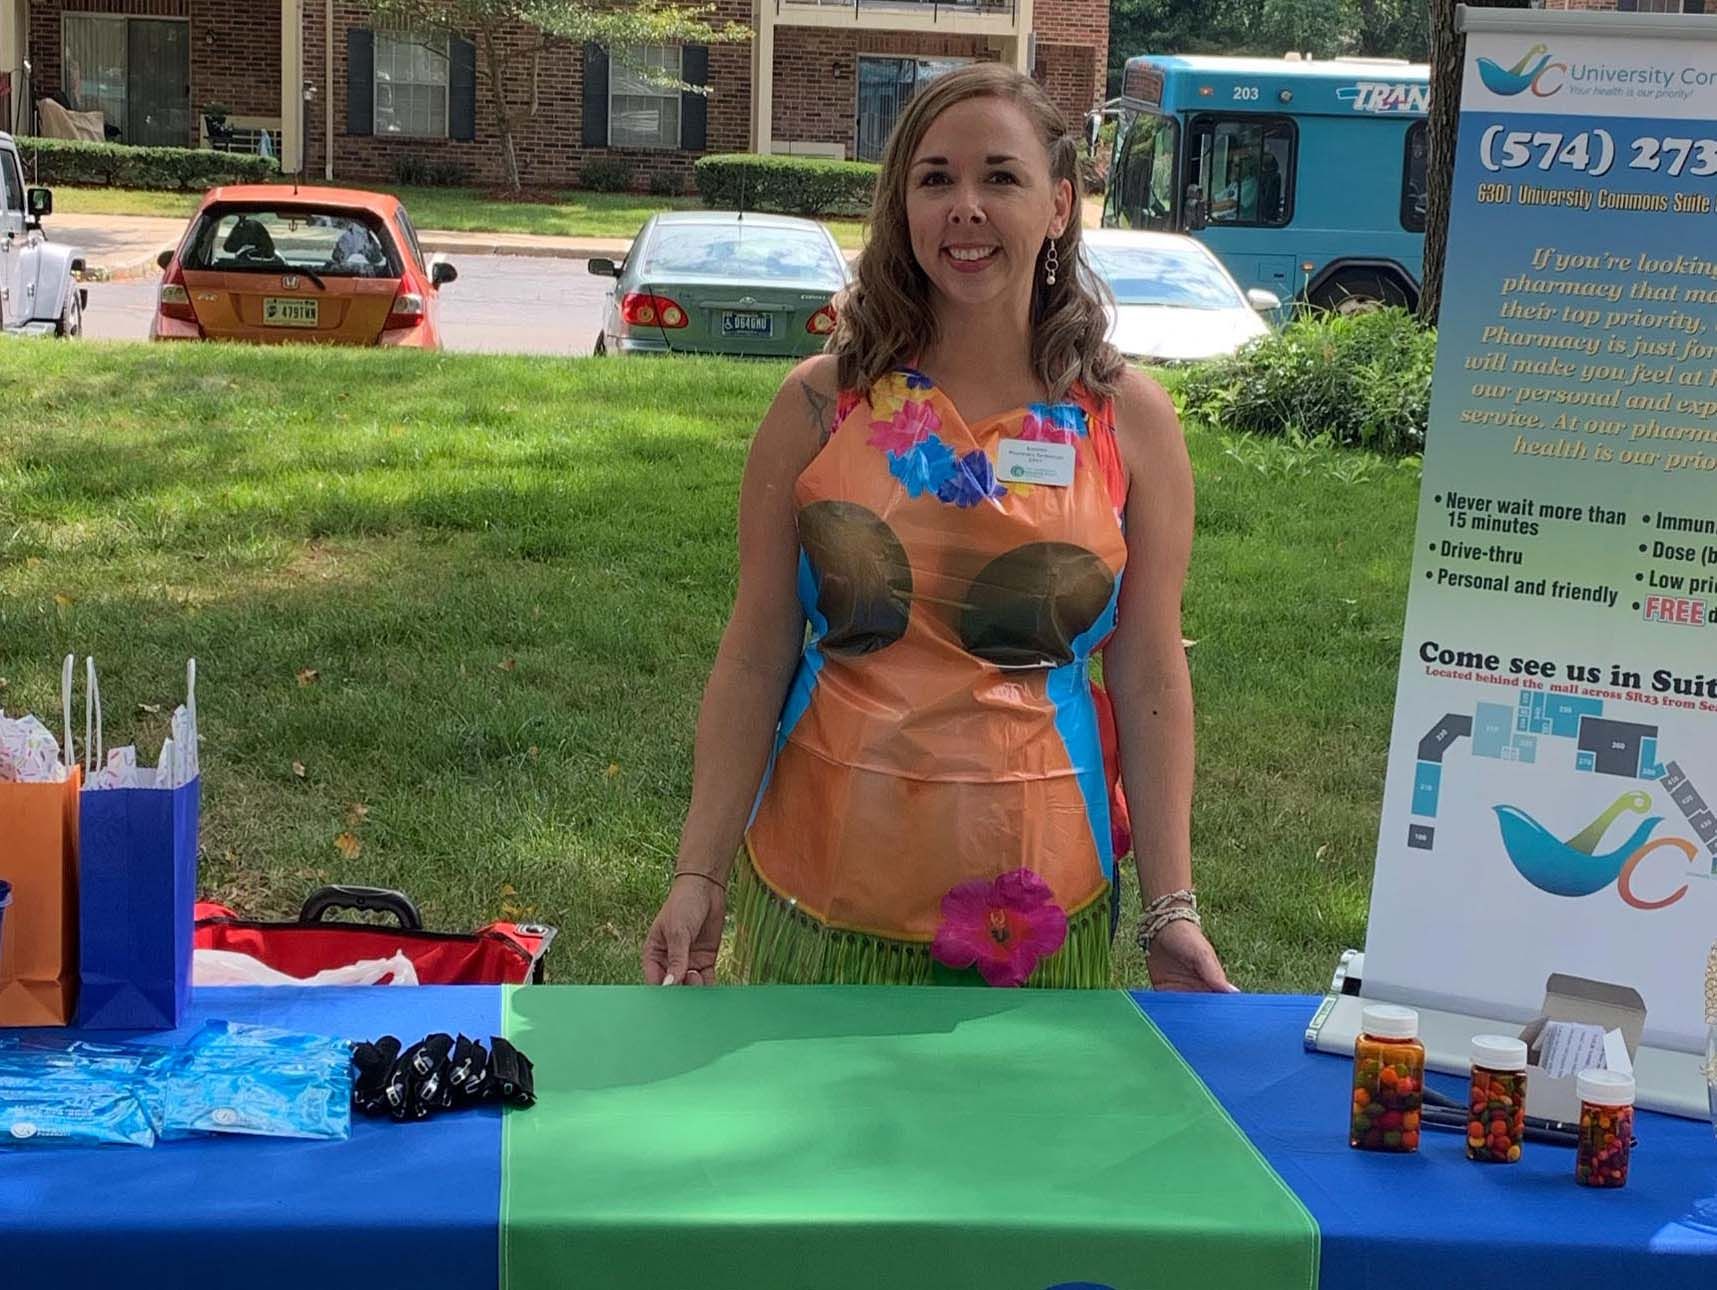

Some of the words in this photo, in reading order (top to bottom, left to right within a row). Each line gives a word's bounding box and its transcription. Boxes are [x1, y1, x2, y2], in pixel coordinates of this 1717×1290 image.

[1571, 64, 1675, 88] University
[1233, 86, 1259, 101] 203
[1480, 125, 1615, 177] (574)
[1628, 137, 1717, 178] 273
[1477, 183, 1512, 205] 6301
[1518, 185, 1592, 211] University
[1598, 189, 1668, 212] Commons
[1673, 192, 1710, 214] Suite
[1531, 247, 1556, 271] If
[1554, 252, 1633, 272] you're
[1500, 273, 1623, 302] pharmacy
[1631, 280, 1679, 302] that
[1500, 299, 1557, 320] their
[1561, 306, 1602, 329] top
[1604, 309, 1707, 335] priority,
[1481, 325, 1602, 355] Pharmacy
[1607, 334, 1627, 353] is
[1628, 335, 1677, 359] just
[1464, 352, 1509, 373] will
[1512, 356, 1577, 377] make
[1580, 364, 1628, 382] you
[1626, 362, 1674, 386] feel
[1678, 370, 1704, 387] at
[1472, 383, 1512, 399] our
[1514, 388, 1622, 409] personal
[1626, 392, 1673, 412] and
[1460, 408, 1546, 429] service.
[1552, 411, 1580, 433] At
[1584, 418, 1628, 437] our
[1512, 434, 1588, 461] health
[1594, 443, 1614, 463] is
[1619, 450, 1663, 466] our
[1446, 491, 1493, 513] Never
[1497, 497, 1534, 516] wait
[1539, 504, 1584, 523] more
[1588, 505, 1627, 526] than
[1448, 511, 1467, 529] 15
[1471, 512, 1540, 537] minutes
[1441, 540, 1524, 565] Drive-thru
[1653, 541, 1697, 562] Dose
[1437, 568, 1509, 593] Personal
[1514, 578, 1546, 597] and
[1551, 580, 1619, 608] friendly
[1649, 569, 1685, 590] Low
[1645, 596, 1706, 625] FREE
[1419, 641, 1500, 671] Come
[1508, 657, 1557, 678] see
[1566, 664, 1602, 683] us
[1609, 664, 1642, 689] in
[1651, 669, 1717, 699] Suit
[1425, 666, 1472, 681] Located
[1475, 673, 1520, 687] behind
[1522, 679, 1544, 691] the
[1550, 683, 1580, 695] mall
[1582, 687, 1622, 700] across
[1625, 690, 1660, 706] SR23
[1662, 695, 1696, 710] from
